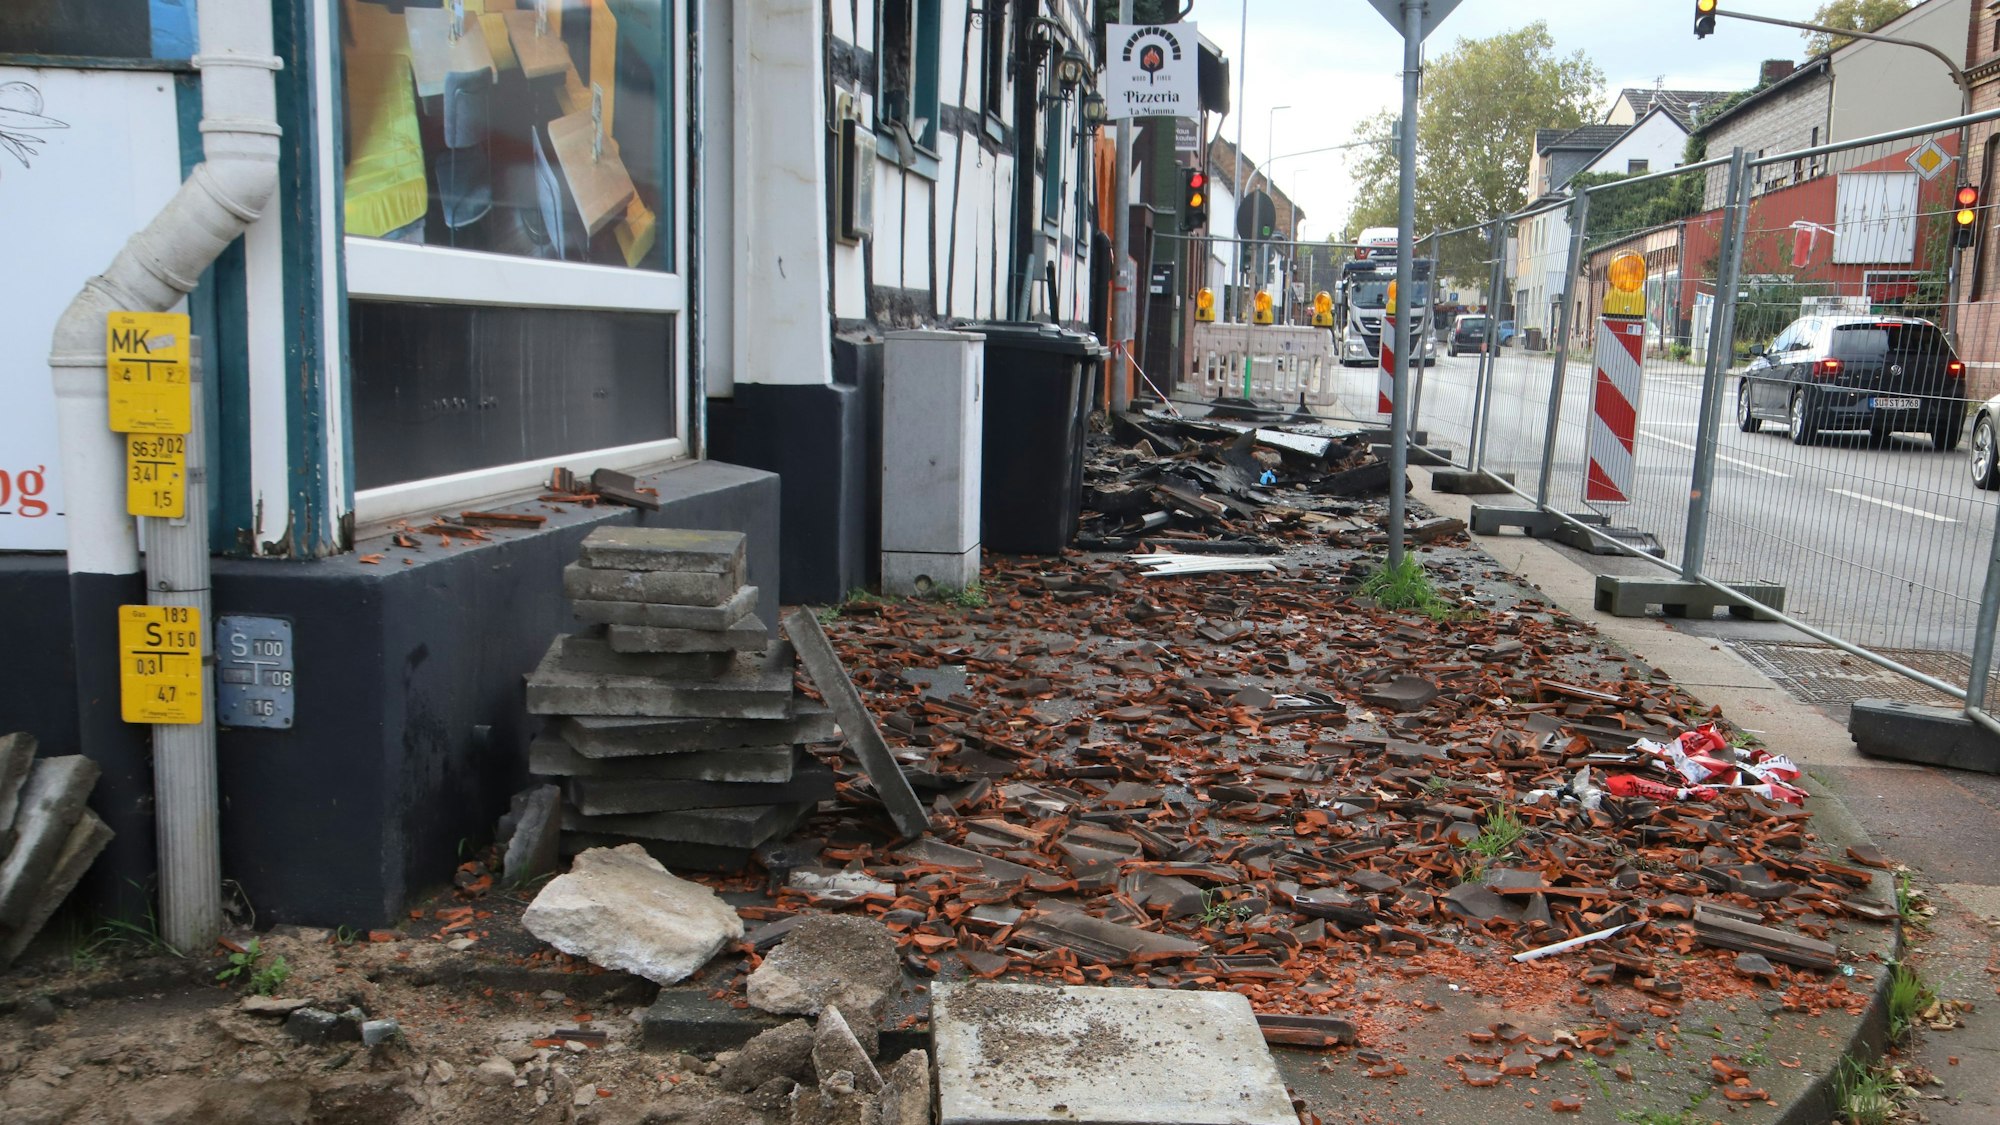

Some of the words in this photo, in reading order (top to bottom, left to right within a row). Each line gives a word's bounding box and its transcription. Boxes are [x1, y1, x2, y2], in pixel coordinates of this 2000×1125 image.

[1123, 90, 1180, 103] Pizzeria
[1142, 107, 1175, 115] Mamma
[112, 328, 151, 354] MK
[132, 610, 147, 618] Gas
[163, 607, 188, 623] 183
[145, 622, 163, 647] S
[166, 630, 197, 648] 150
[230, 632, 248, 657] S
[253, 641, 283, 657] 100
[271, 671, 292, 686] 08
